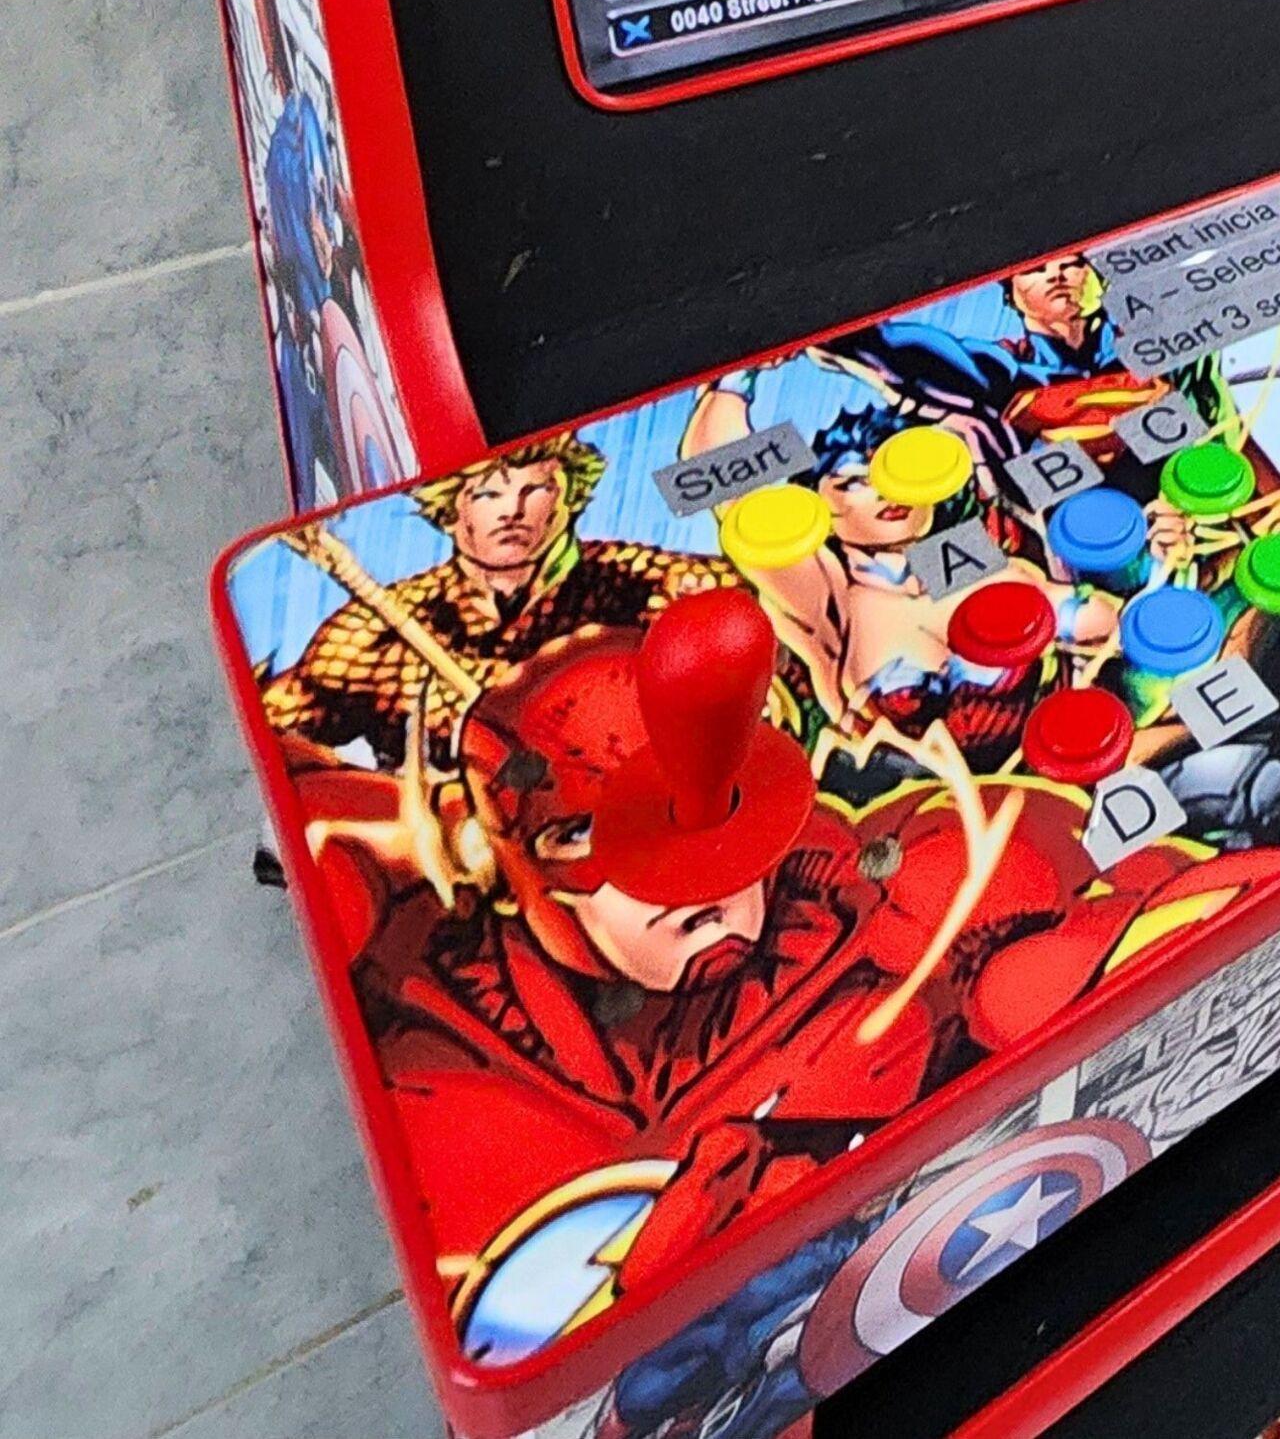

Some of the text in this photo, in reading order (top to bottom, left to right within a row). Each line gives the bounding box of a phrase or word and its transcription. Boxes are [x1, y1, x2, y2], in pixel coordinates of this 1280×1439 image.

[671, 1, 723, 33] 0040
[1105, 233, 1196, 275] Start
[1198, 202, 1279, 246] inicia
[1124, 295, 1154, 320] A
[1132, 319, 1219, 367] Start
[1221, 305, 1251, 331] 3
[1142, 405, 1189, 446] C
[671, 438, 793, 504] Start
[1032, 449, 1084, 492] B
[938, 541, 988, 590] A
[1197, 670, 1253, 725] E
[1101, 783, 1159, 841] D
